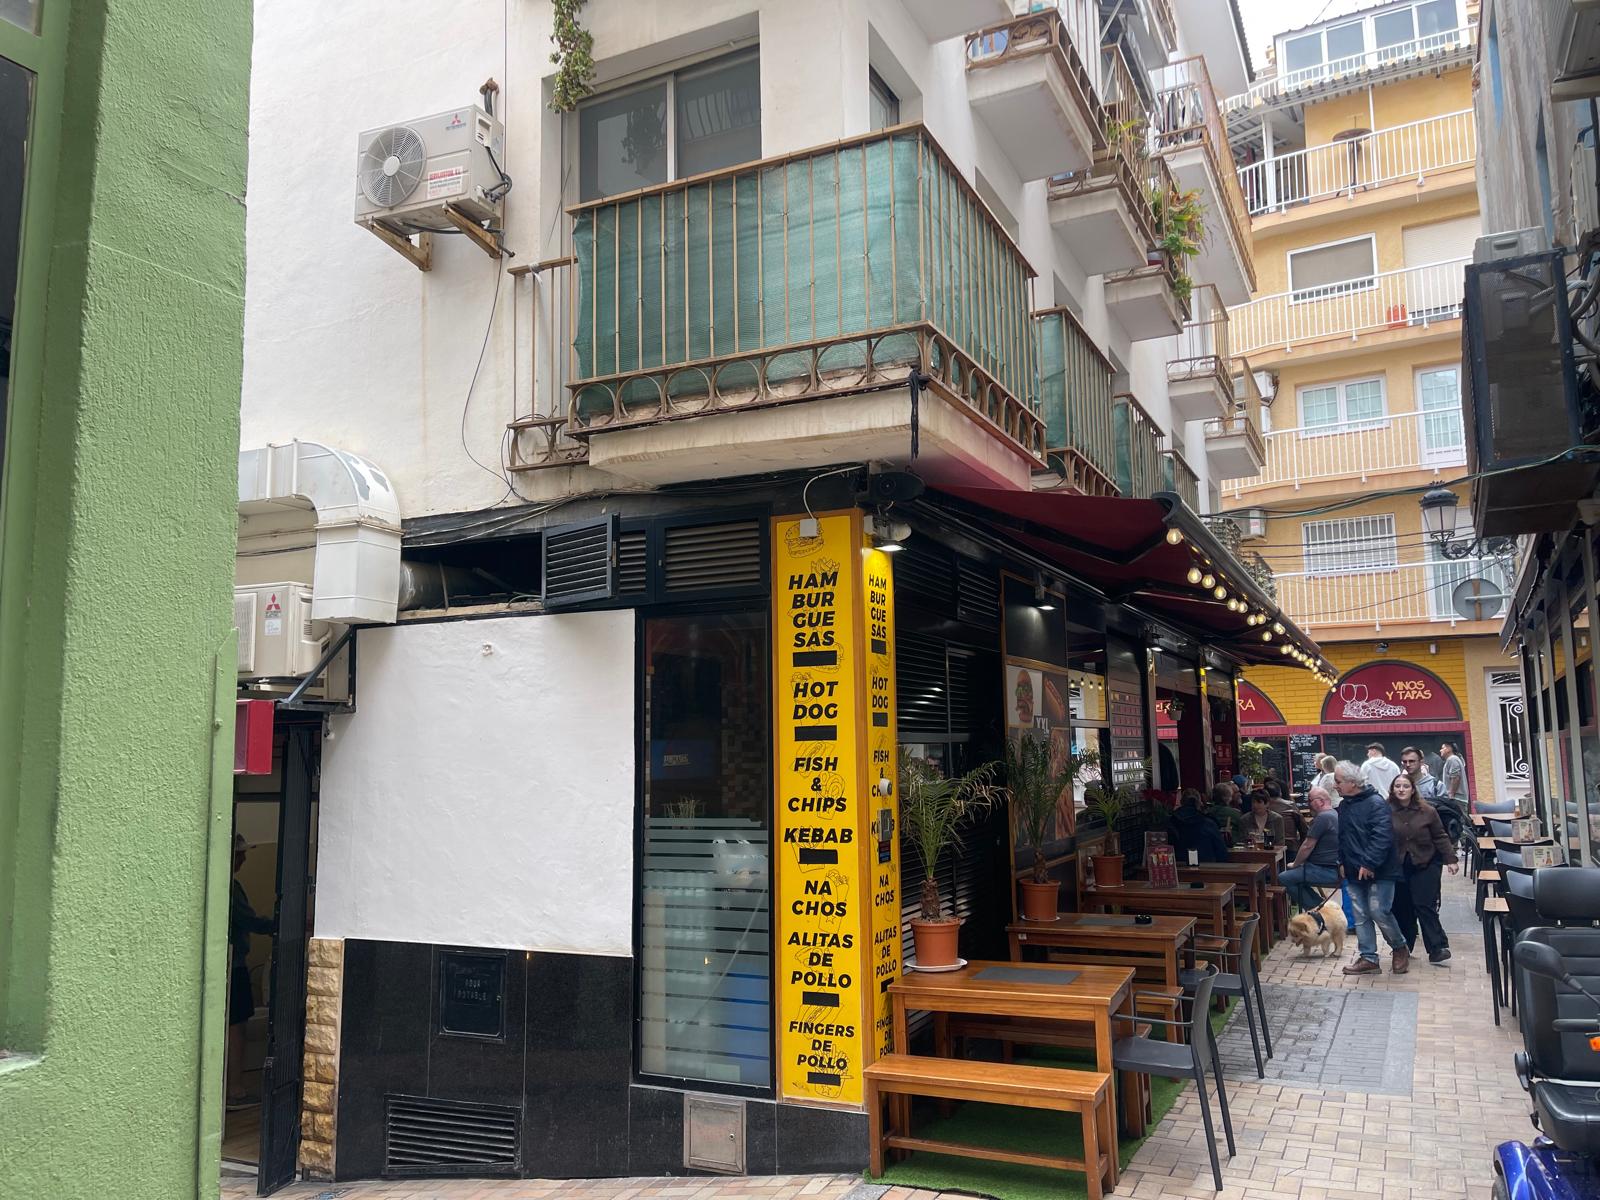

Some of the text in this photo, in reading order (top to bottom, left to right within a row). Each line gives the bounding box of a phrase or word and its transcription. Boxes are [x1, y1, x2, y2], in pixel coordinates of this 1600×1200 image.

[788, 572, 839, 590] HAM
[868, 573, 888, 591] HAM
[791, 591, 835, 609] BUR
[870, 590, 886, 606] BUR
[792, 611, 836, 629] GUE
[870, 607, 887, 623] GUE
[793, 631, 835, 648] SAS
[871, 624, 887, 639] SAS
[793, 681, 839, 699] HOT
[872, 676, 889, 691] HOT
[1392, 680, 1426, 691] VINOS
[872, 694, 889, 709] DOG
[1386, 689, 1432, 701] Y TAPAS
[793, 703, 838, 720] DOG
[793, 757, 838, 772] FISH
[873, 750, 890, 763] FISH
[810, 777, 822, 792] &
[787, 797, 847, 813] CHIPS
[784, 828, 853, 844] KEBAB
[804, 880, 832, 896] NA
[879, 874, 890, 888] NA
[875, 889, 895, 907] CHOS
[791, 900, 847, 917] CHOS
[787, 932, 854, 949] ALITAS
[874, 925, 897, 946] ALITAS
[881, 944, 891, 958] DE
[808, 952, 834, 968] DE
[875, 959, 897, 979] POLLO
[791, 971, 852, 989] POLLO
[789, 1021, 855, 1038] FINGERS
[811, 1039, 833, 1053] DE
[797, 1054, 848, 1071] POLLO
